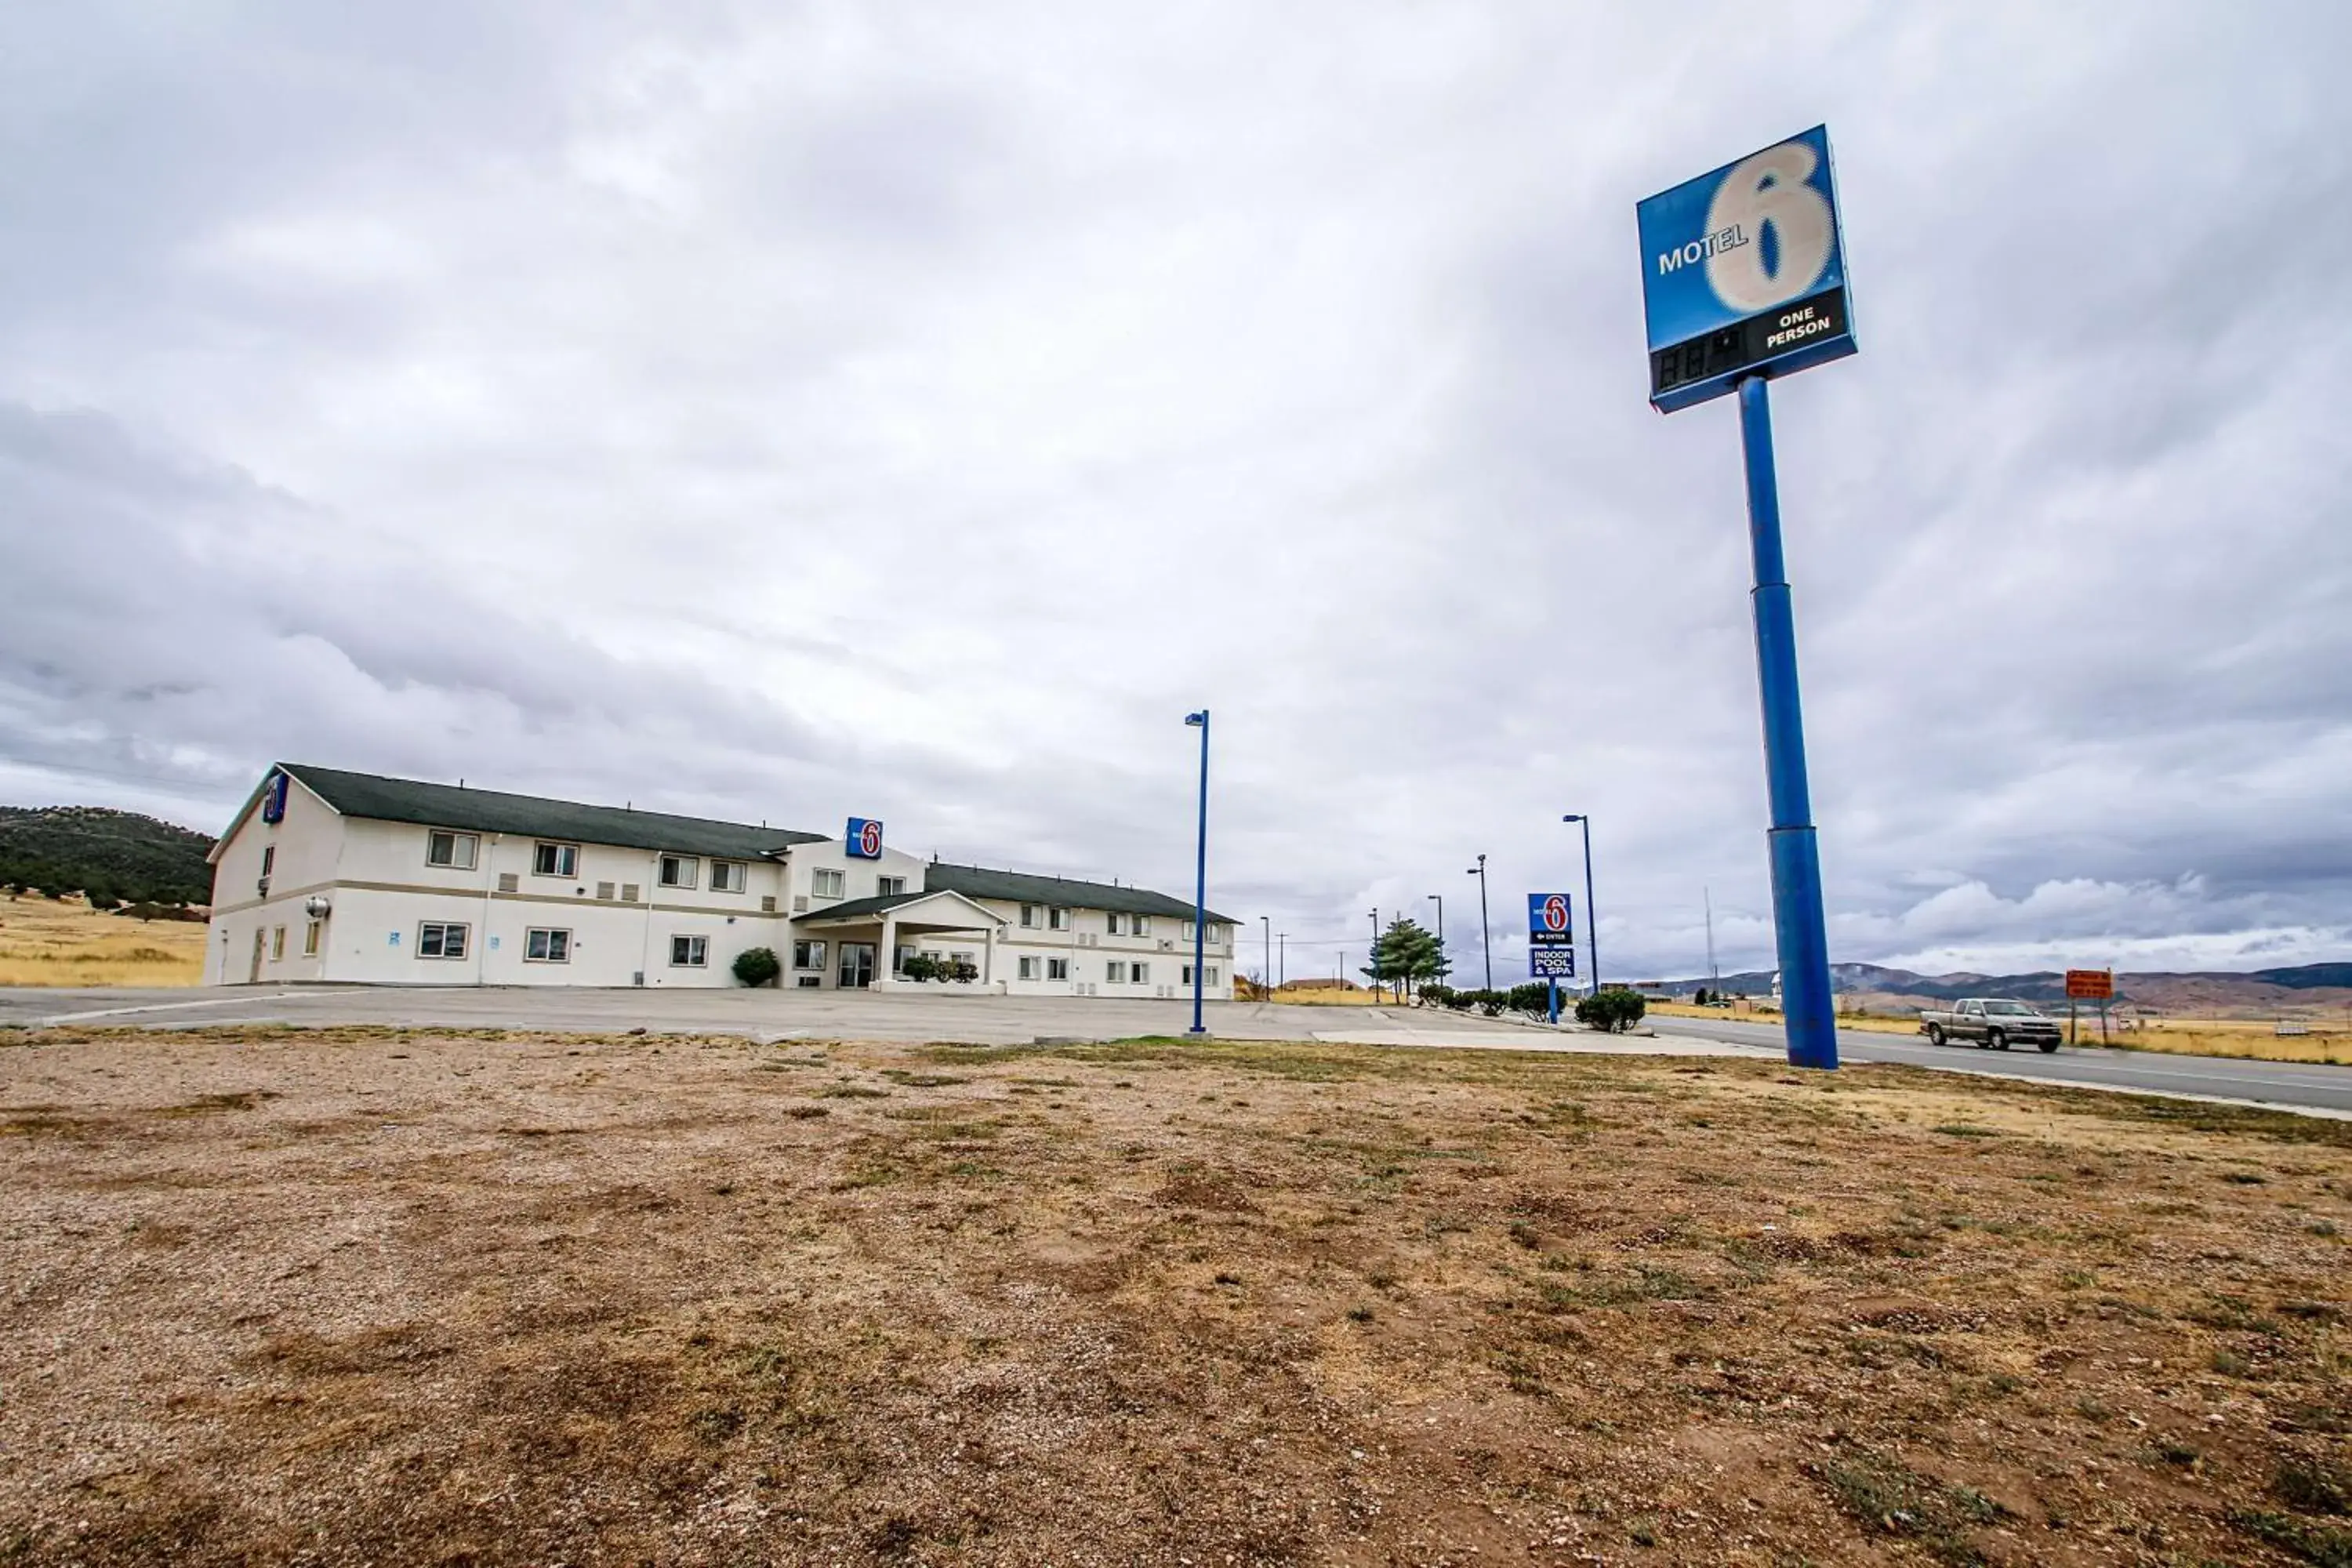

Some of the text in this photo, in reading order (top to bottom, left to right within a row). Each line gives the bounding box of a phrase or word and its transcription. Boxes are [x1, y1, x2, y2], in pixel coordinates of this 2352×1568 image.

[1658, 142, 1833, 312] MOTEL 6
[1766, 318, 1831, 348] PERSON
[1780, 307, 1814, 327] ONE
[861, 822, 880, 856] 6
[1544, 895, 1568, 931] 6
